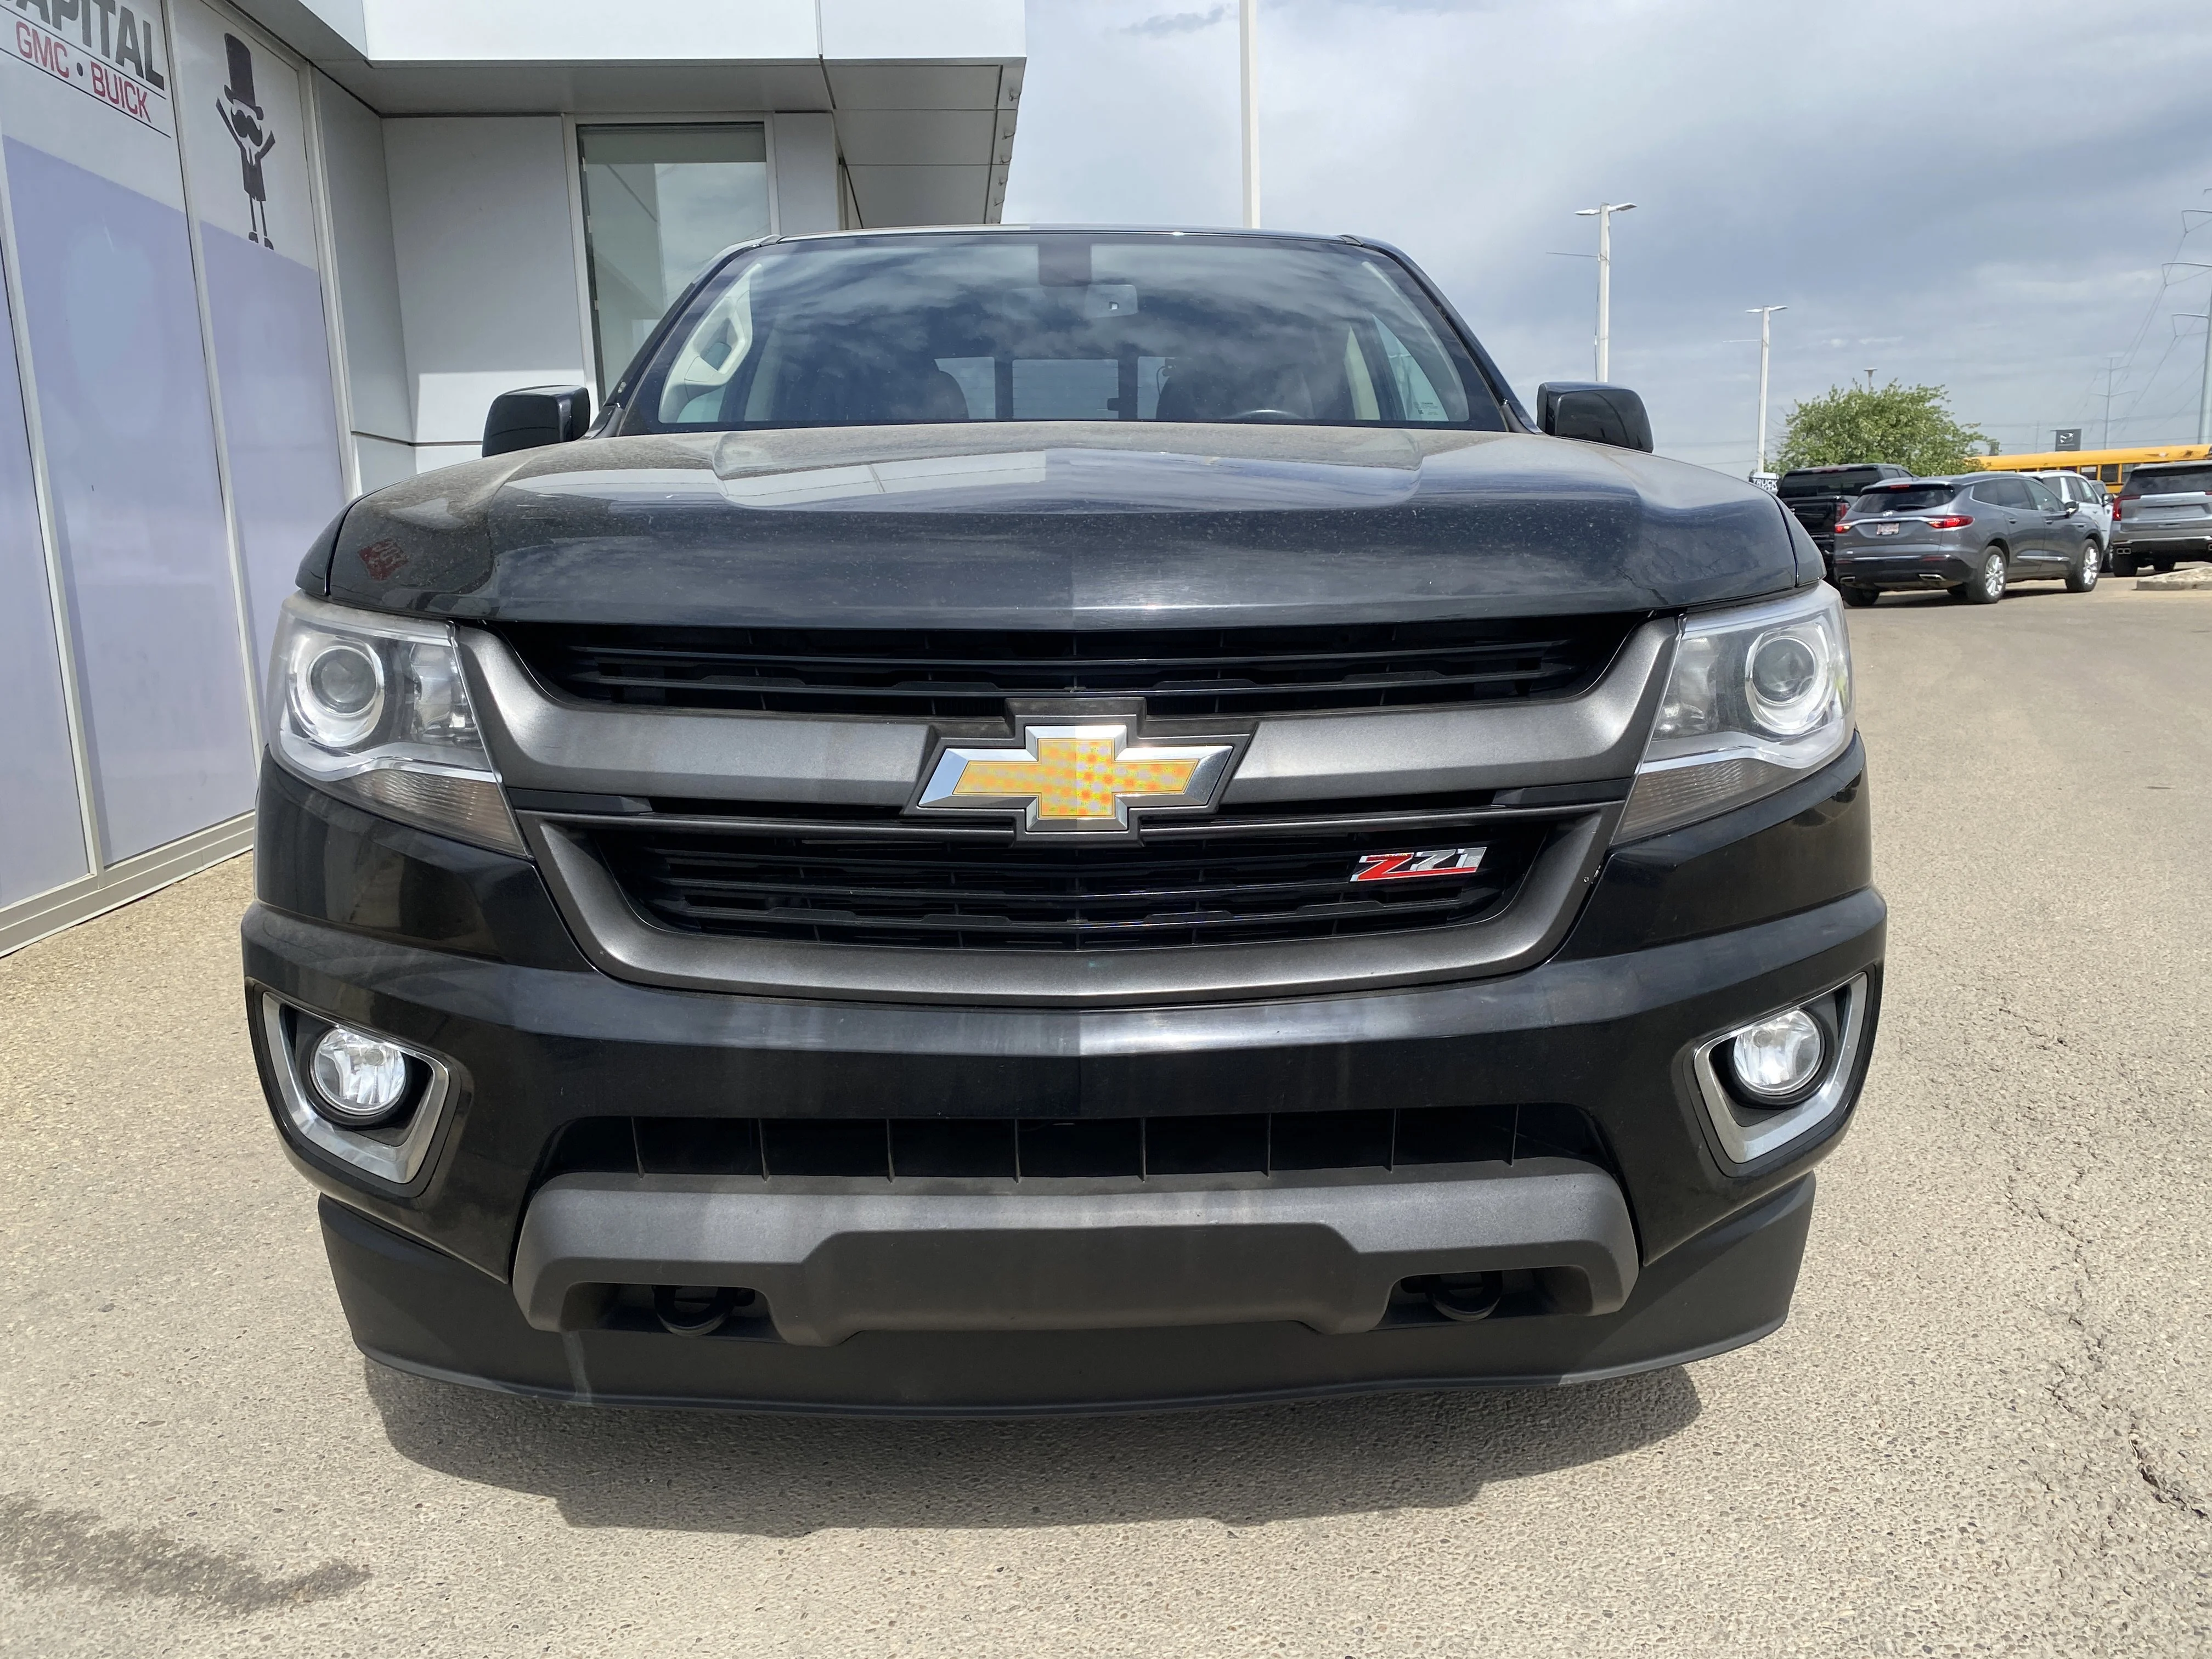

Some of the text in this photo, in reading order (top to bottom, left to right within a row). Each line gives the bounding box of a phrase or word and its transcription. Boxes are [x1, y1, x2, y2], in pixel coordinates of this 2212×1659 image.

[4, 0, 165, 91] PITAL
[16, 21, 151, 123] GMC BUICK
[1350, 847, 1487, 882] Z71
